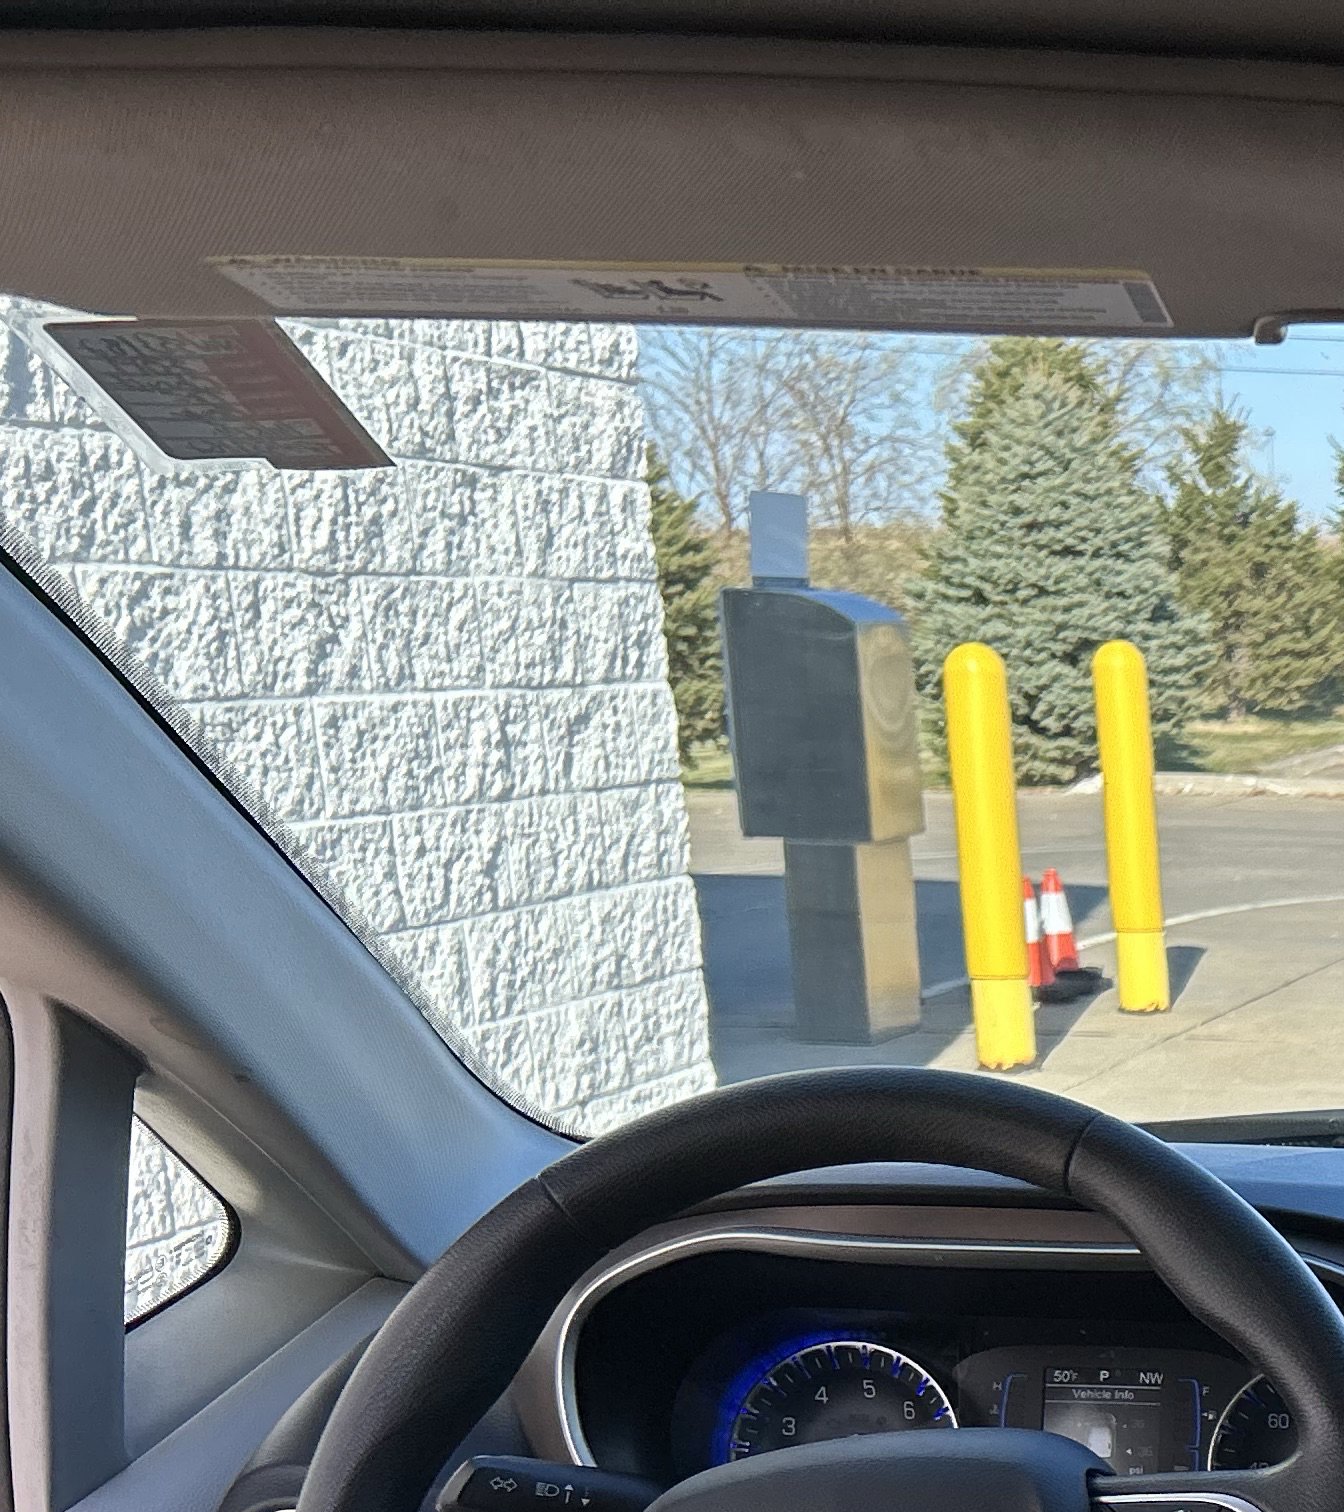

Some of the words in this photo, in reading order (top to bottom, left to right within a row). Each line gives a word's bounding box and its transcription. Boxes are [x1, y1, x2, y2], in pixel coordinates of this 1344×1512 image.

[1100, 1370, 1110, 1382] P
[1139, 1371, 1164, 1385] NW
[814, 1385, 829, 1405] 4
[863, 1379, 877, 1399] 5
[1072, 1388, 1111, 1400] Vehicle
[1114, 1389, 1135, 1401] Info
[903, 1400, 916, 1420] 6
[782, 1416, 796, 1436] 3
[1267, 1413, 1290, 1430] 60
